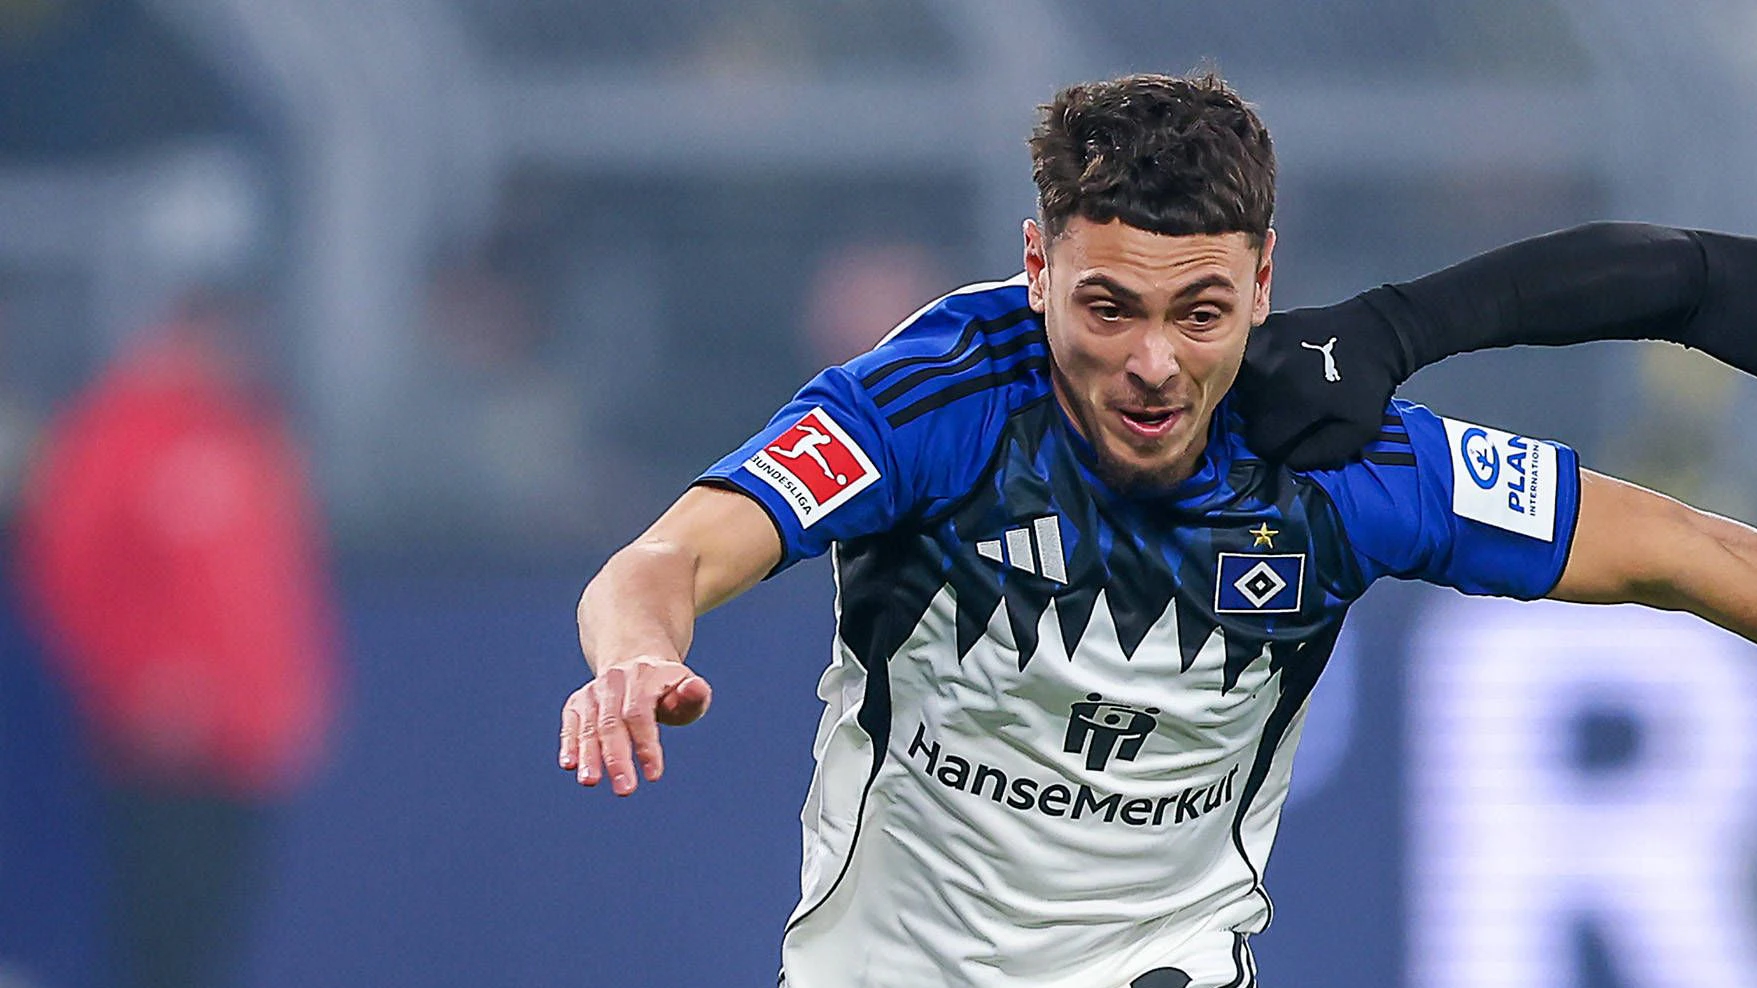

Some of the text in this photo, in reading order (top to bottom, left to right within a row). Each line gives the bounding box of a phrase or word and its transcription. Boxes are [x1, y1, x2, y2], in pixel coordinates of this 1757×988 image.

[750, 455, 812, 515] BUNDESLIGA
[1529, 443, 1540, 517] INTERNATION
[907, 721, 1240, 826] HanseMerkur
